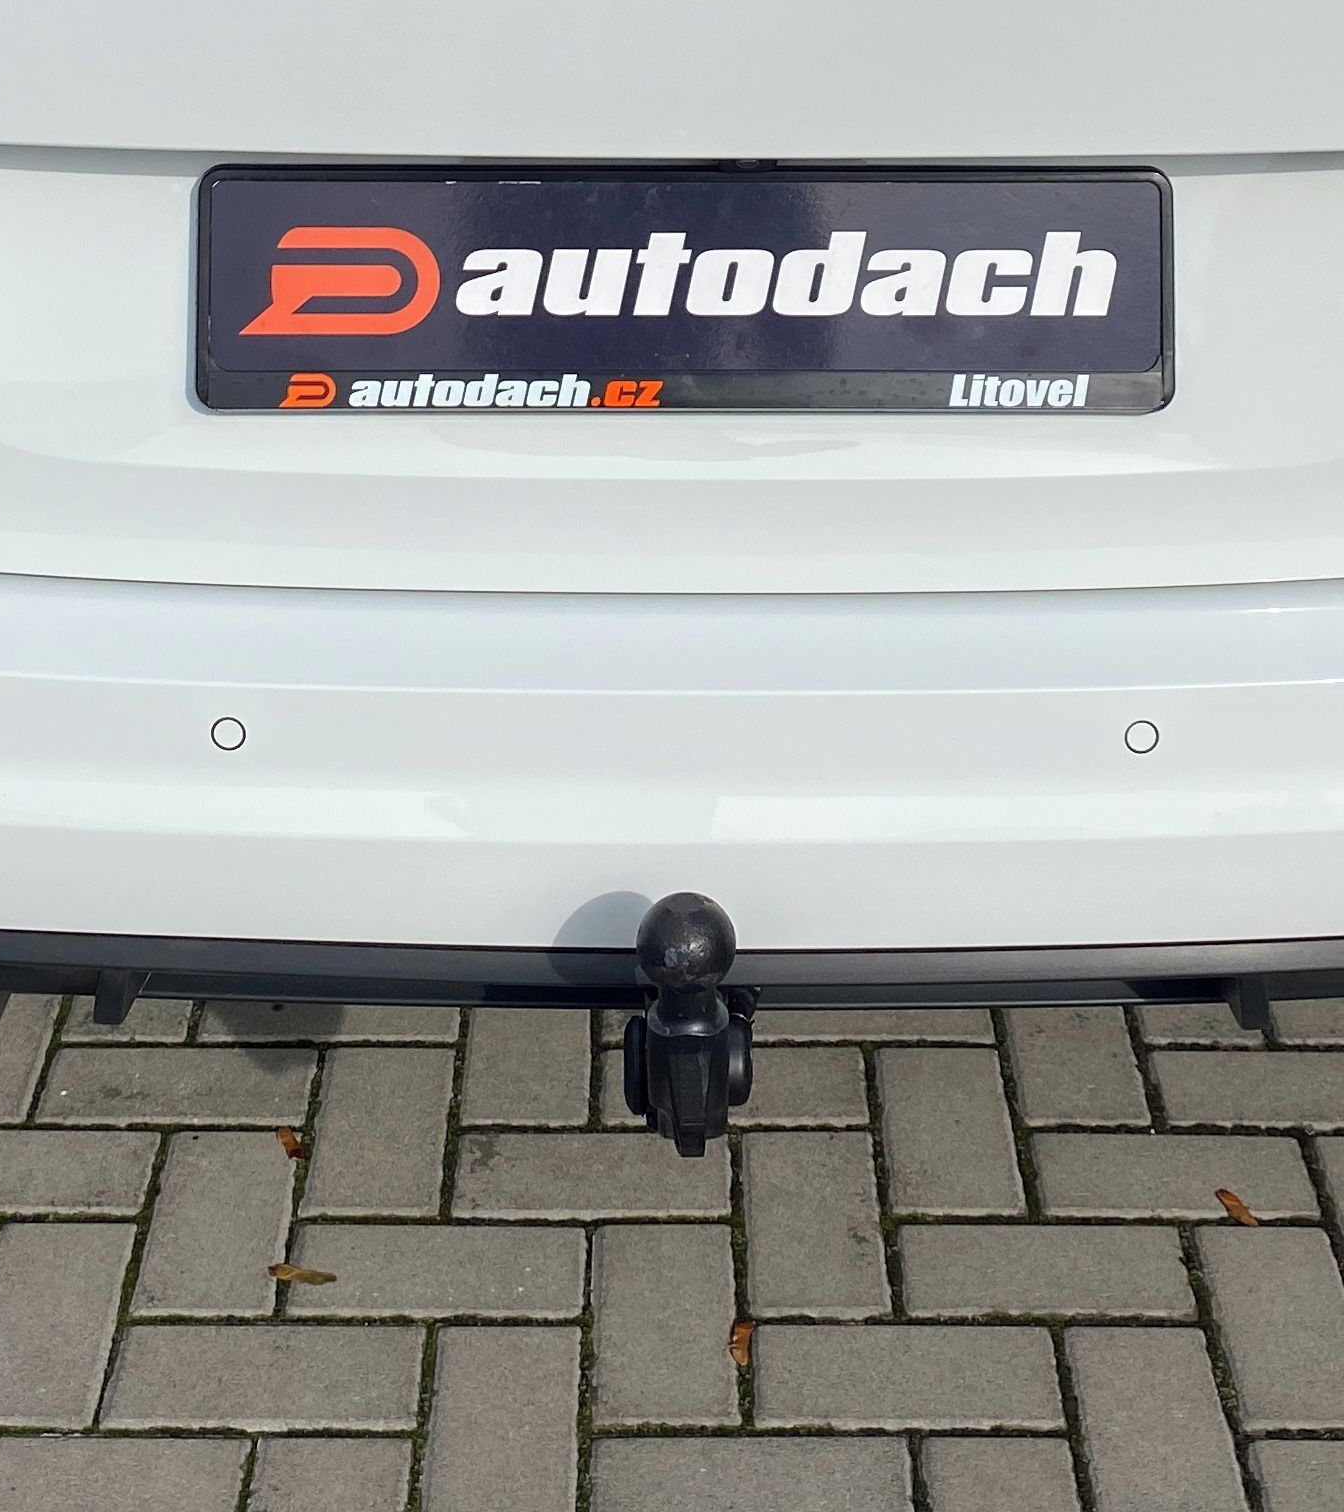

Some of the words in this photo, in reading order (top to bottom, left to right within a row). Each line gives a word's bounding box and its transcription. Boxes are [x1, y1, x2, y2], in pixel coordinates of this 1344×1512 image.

[455, 230, 1118, 318] autodach
[348, 373, 663, 408] autodach.cz
[948, 373, 1090, 408] Litovel
